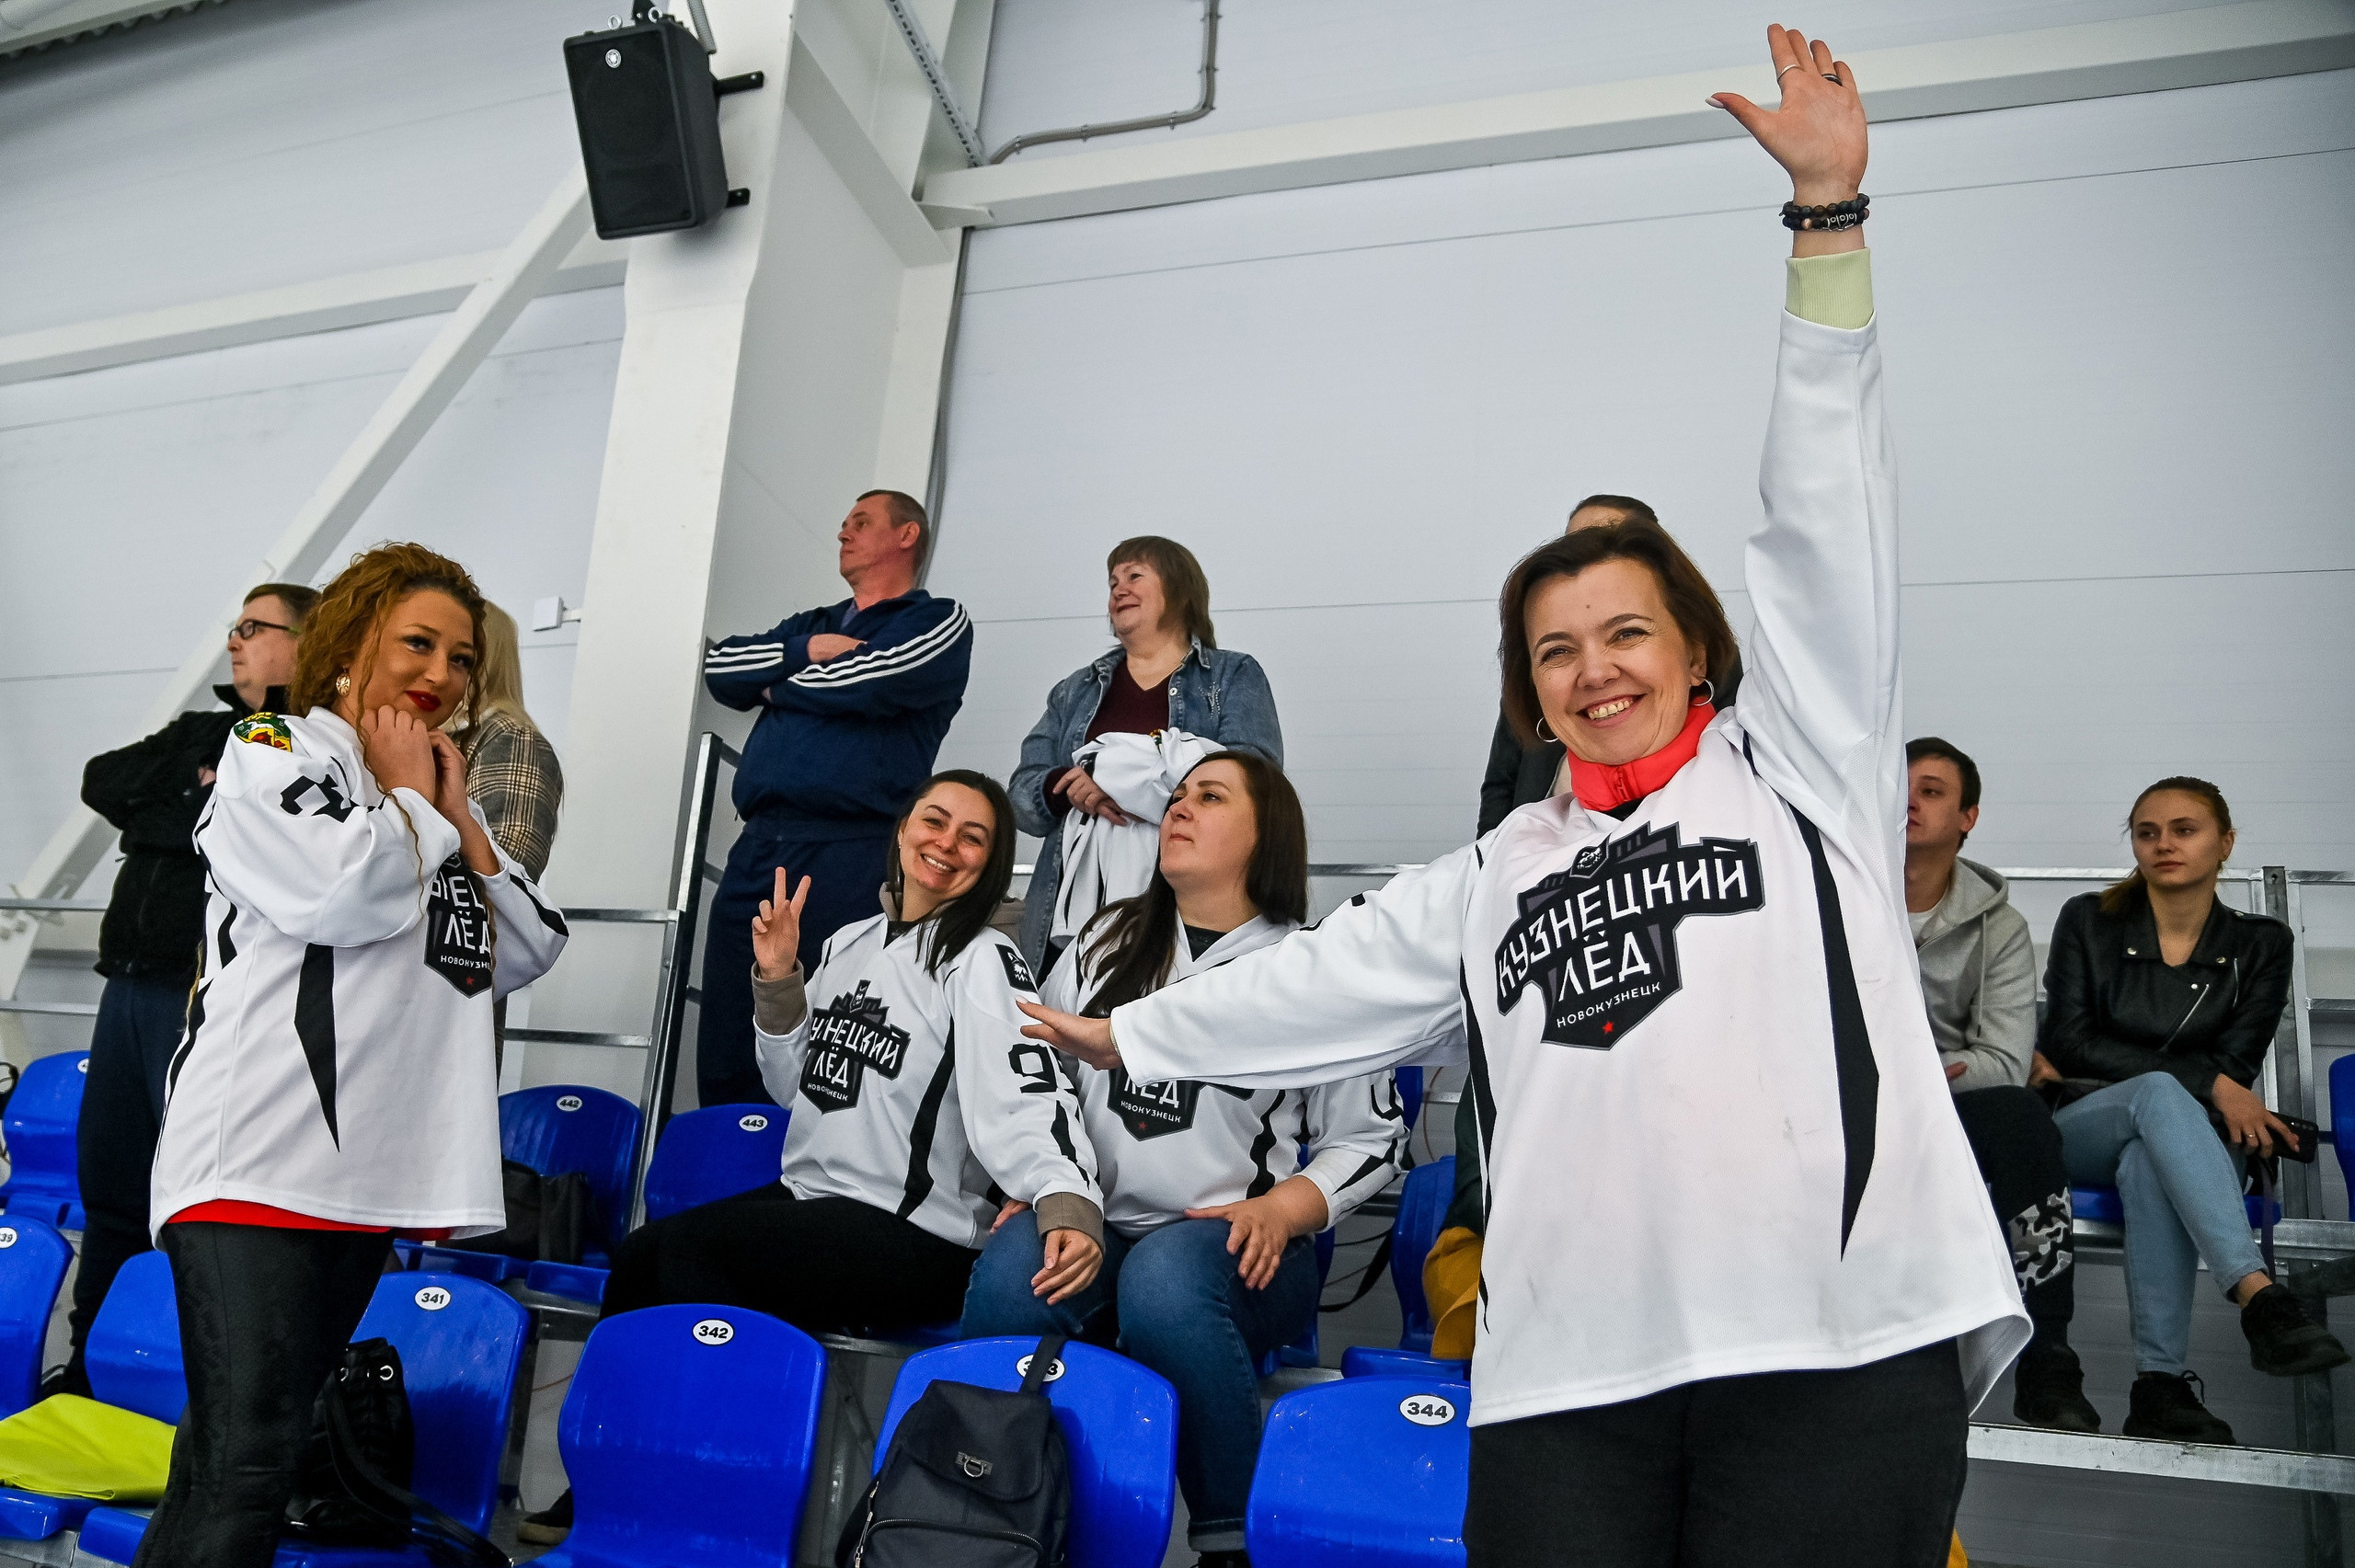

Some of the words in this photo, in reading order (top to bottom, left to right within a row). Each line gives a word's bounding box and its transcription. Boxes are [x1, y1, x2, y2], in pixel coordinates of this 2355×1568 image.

[1498, 846, 1748, 999] КУЗНЕЦКИЙ
[440, 956, 489, 969] НОВОКУЗН
[1557, 930, 1651, 1002] ЛЁД
[1556, 980, 1661, 1028] НОВОКУЗНЕЦК
[810, 1016, 901, 1070] УНЕЦКИЙ
[812, 1046, 849, 1089] ЛЁД
[807, 1082, 848, 1102] НОВОНЕЦК
[559, 1099, 580, 1109] 442
[742, 1118, 764, 1127] 443
[0, 1232, 14, 1242] 39
[420, 1292, 445, 1305] 341
[698, 1325, 729, 1339] 342
[1023, 1360, 1059, 1376] 33
[1407, 1402, 1448, 1419] 344
